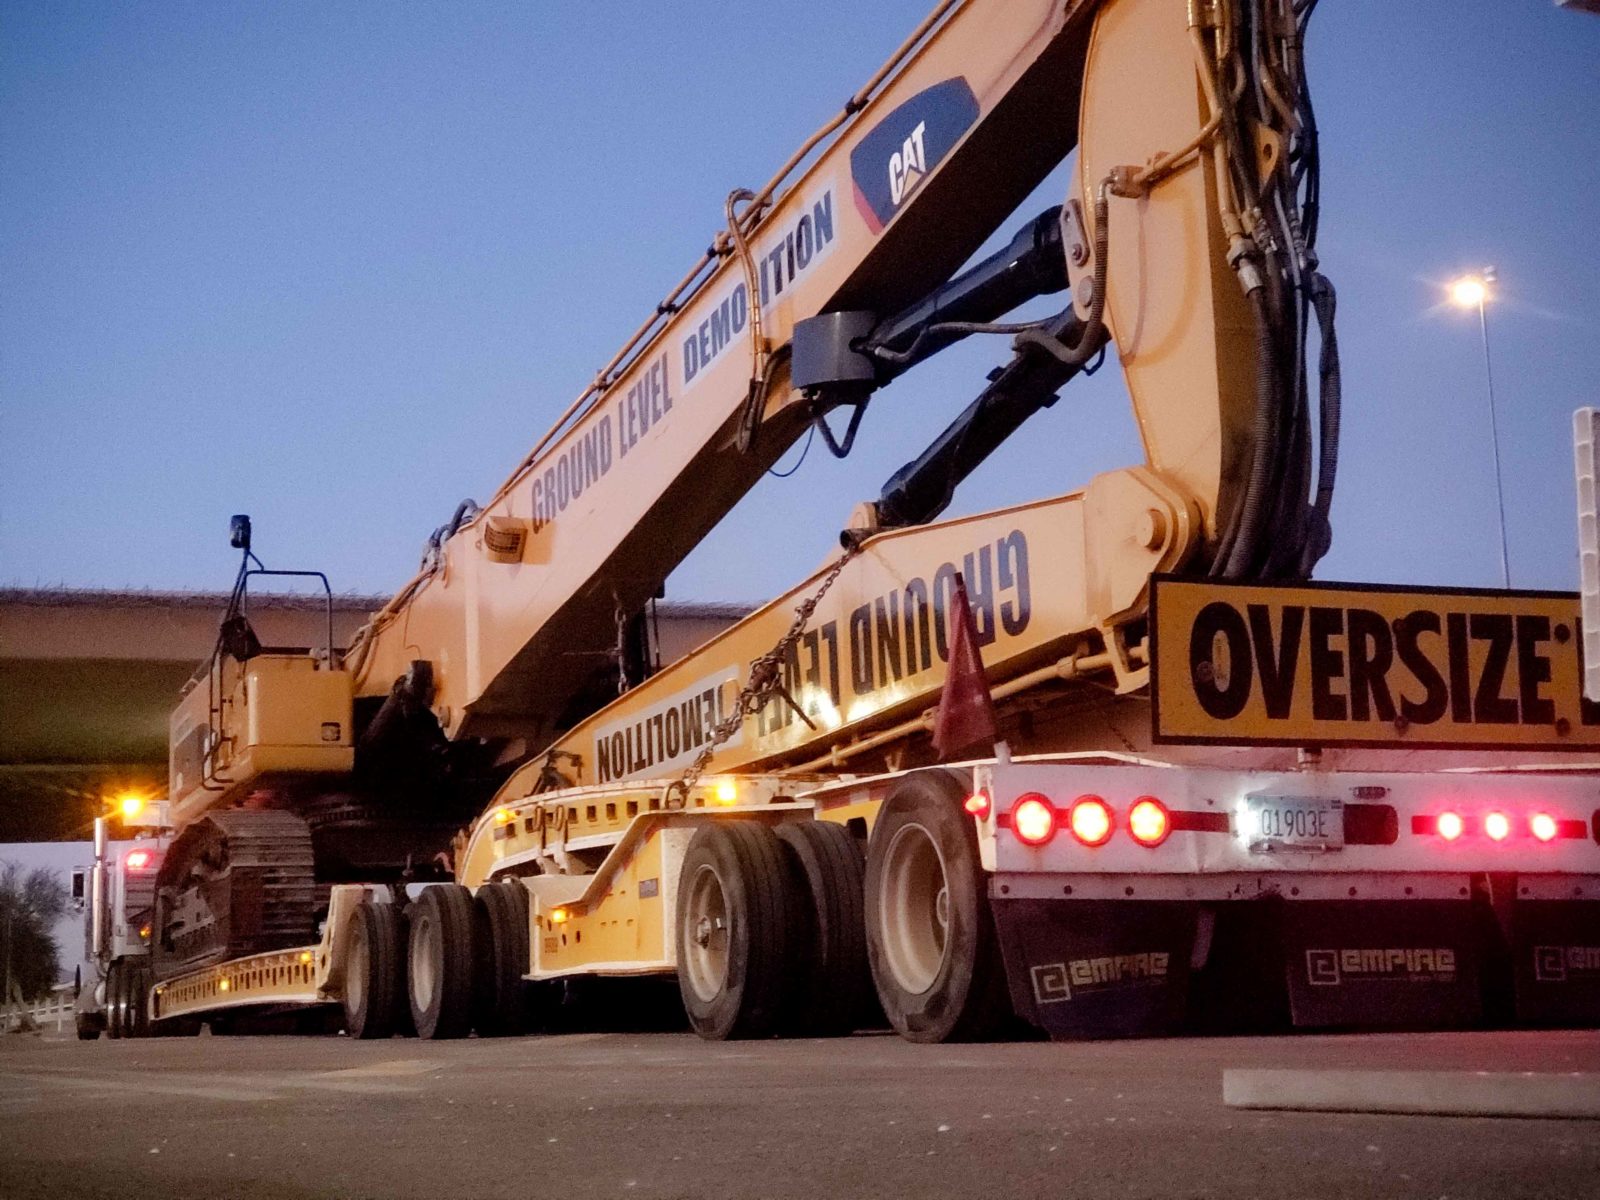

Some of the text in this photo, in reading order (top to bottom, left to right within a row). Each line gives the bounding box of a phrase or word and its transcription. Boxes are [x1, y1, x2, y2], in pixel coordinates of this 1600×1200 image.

[888, 120, 927, 206] CAT
[531, 189, 834, 535] GROUND LEVEL DEMOITION
[849, 528, 1031, 696] GROUND
[1188, 600, 1556, 726] OVERSIZE
